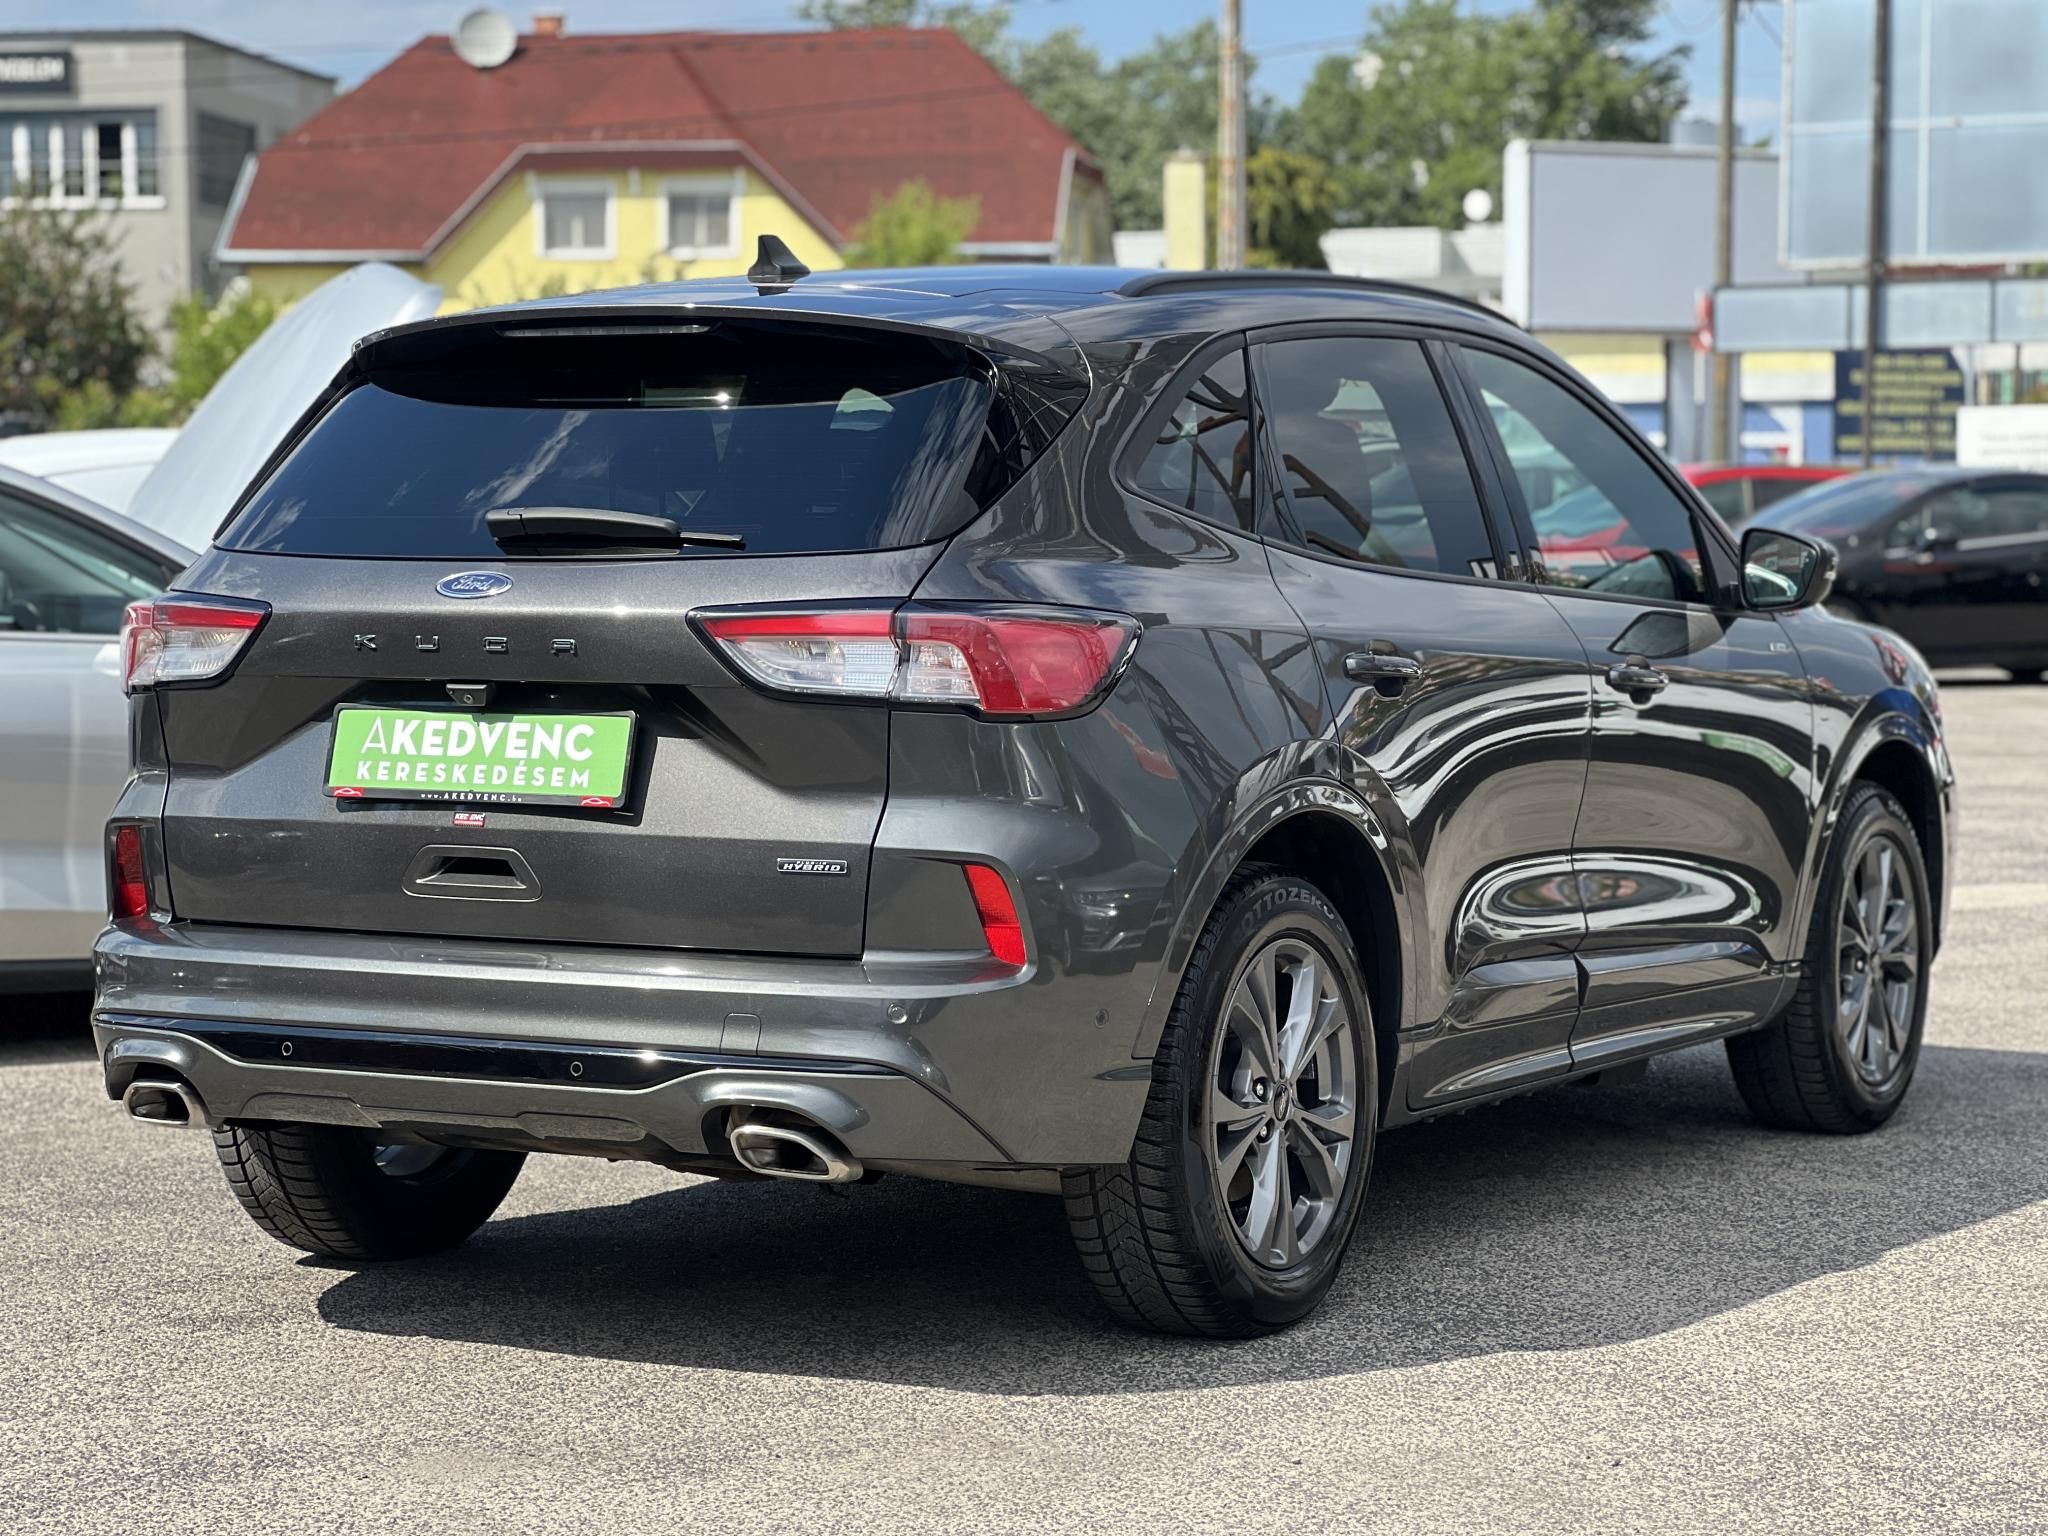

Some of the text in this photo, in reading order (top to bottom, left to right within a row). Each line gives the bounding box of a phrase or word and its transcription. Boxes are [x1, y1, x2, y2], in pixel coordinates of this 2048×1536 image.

[354, 634, 578, 656] KUGA
[356, 760, 591, 788] KERESKEDÉSEM
[783, 863, 841, 872] HYBRID
